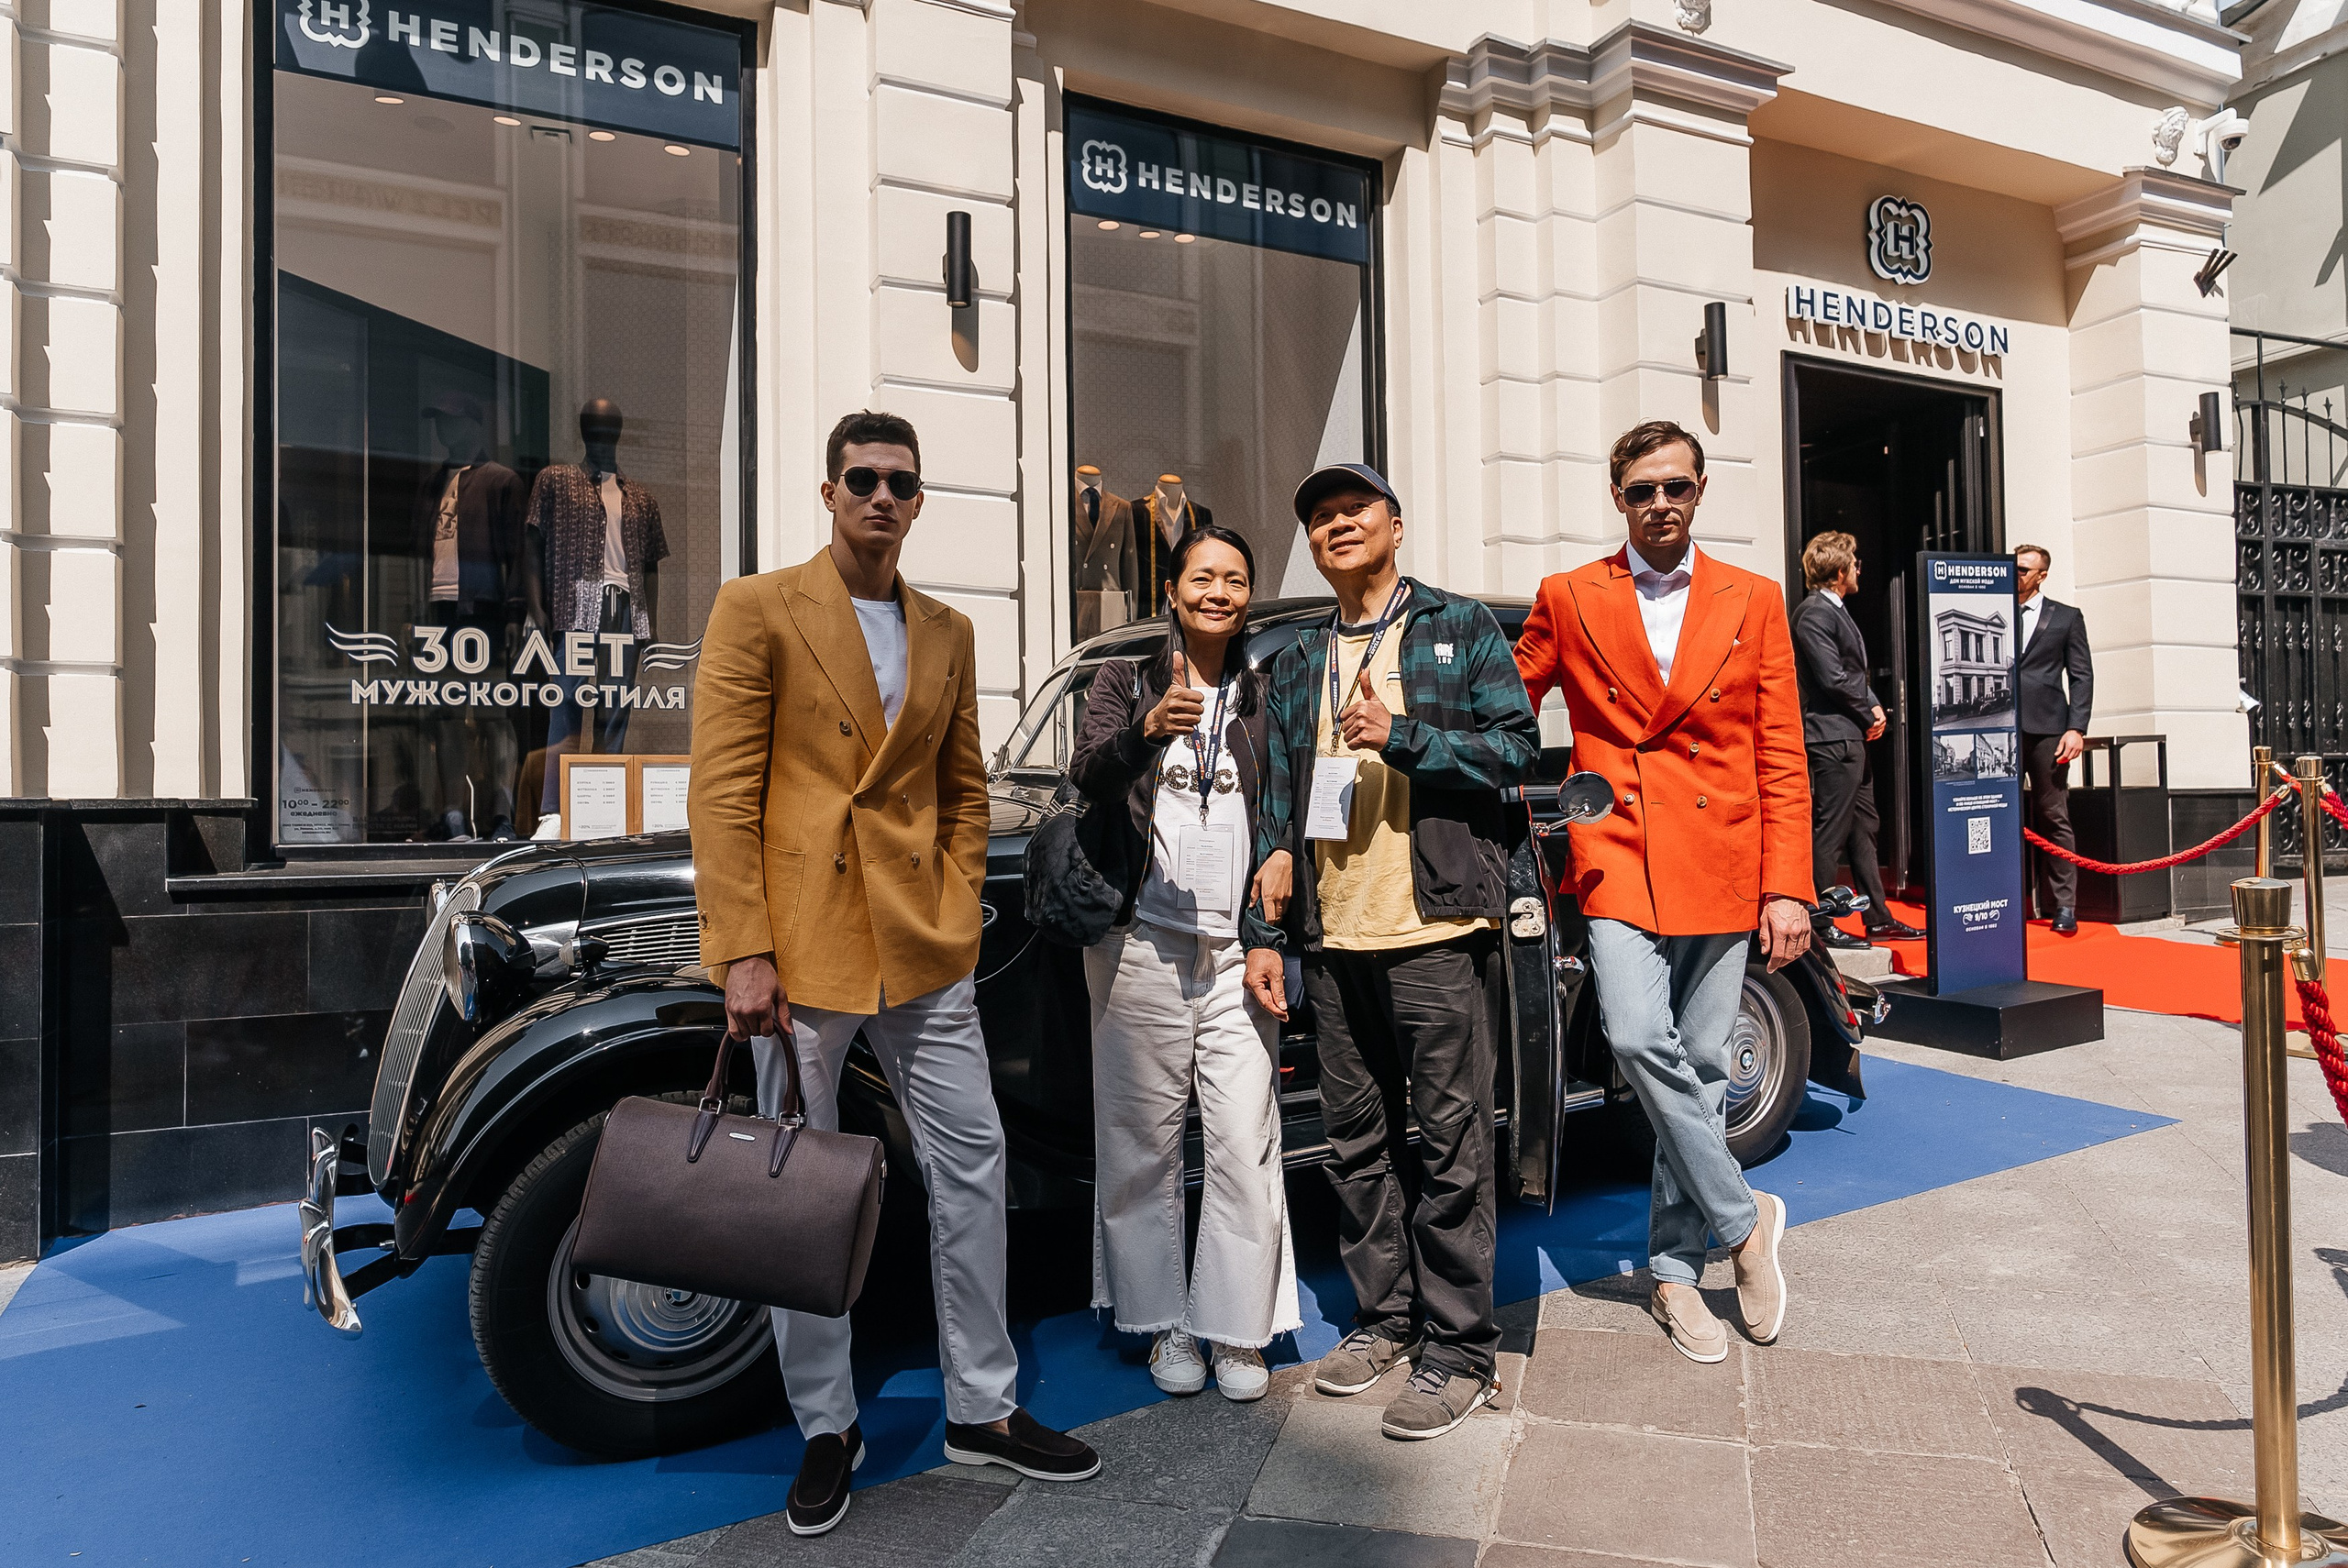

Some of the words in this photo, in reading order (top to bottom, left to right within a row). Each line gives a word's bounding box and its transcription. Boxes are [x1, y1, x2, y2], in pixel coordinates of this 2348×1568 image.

[388, 10, 724, 105] HENDERSON
[1138, 161, 1357, 228] HENDERSON
[1888, 221, 1916, 259] H
[1790, 285, 2009, 356] HENDERSON
[1947, 565, 2007, 577] HENDERSON
[413, 625, 490, 675] 30
[512, 629, 635, 678] ЛЕТ
[351, 679, 564, 708] МУЖСКОГО
[574, 684, 686, 710] СТИЛЯ
[1954, 900, 1989, 913] КУЗНЕЦКИЙ
[1990, 899, 2008, 909] МОСТ
[1975, 911, 1988, 922] 9/10
